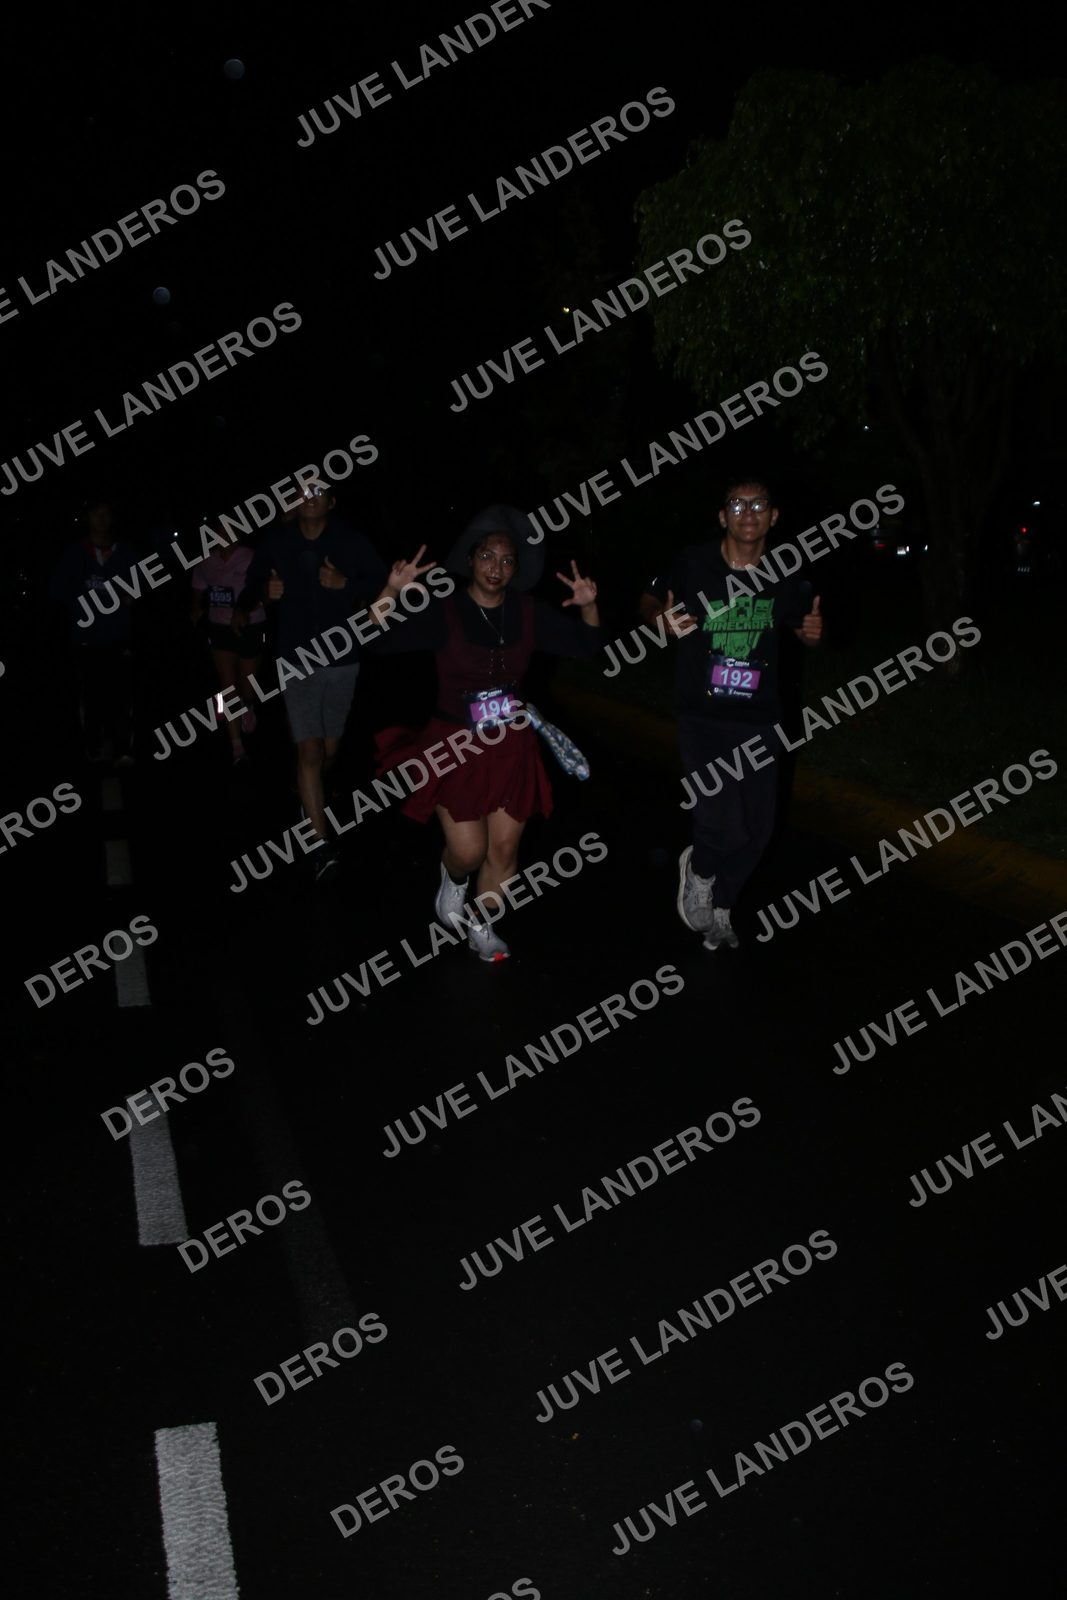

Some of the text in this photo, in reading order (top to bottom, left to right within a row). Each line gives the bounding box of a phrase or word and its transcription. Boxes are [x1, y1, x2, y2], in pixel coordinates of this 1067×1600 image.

[702, 619, 774, 632] MINECRAFT
[721, 668, 753, 688] 192
[478, 696, 511, 719] 194
